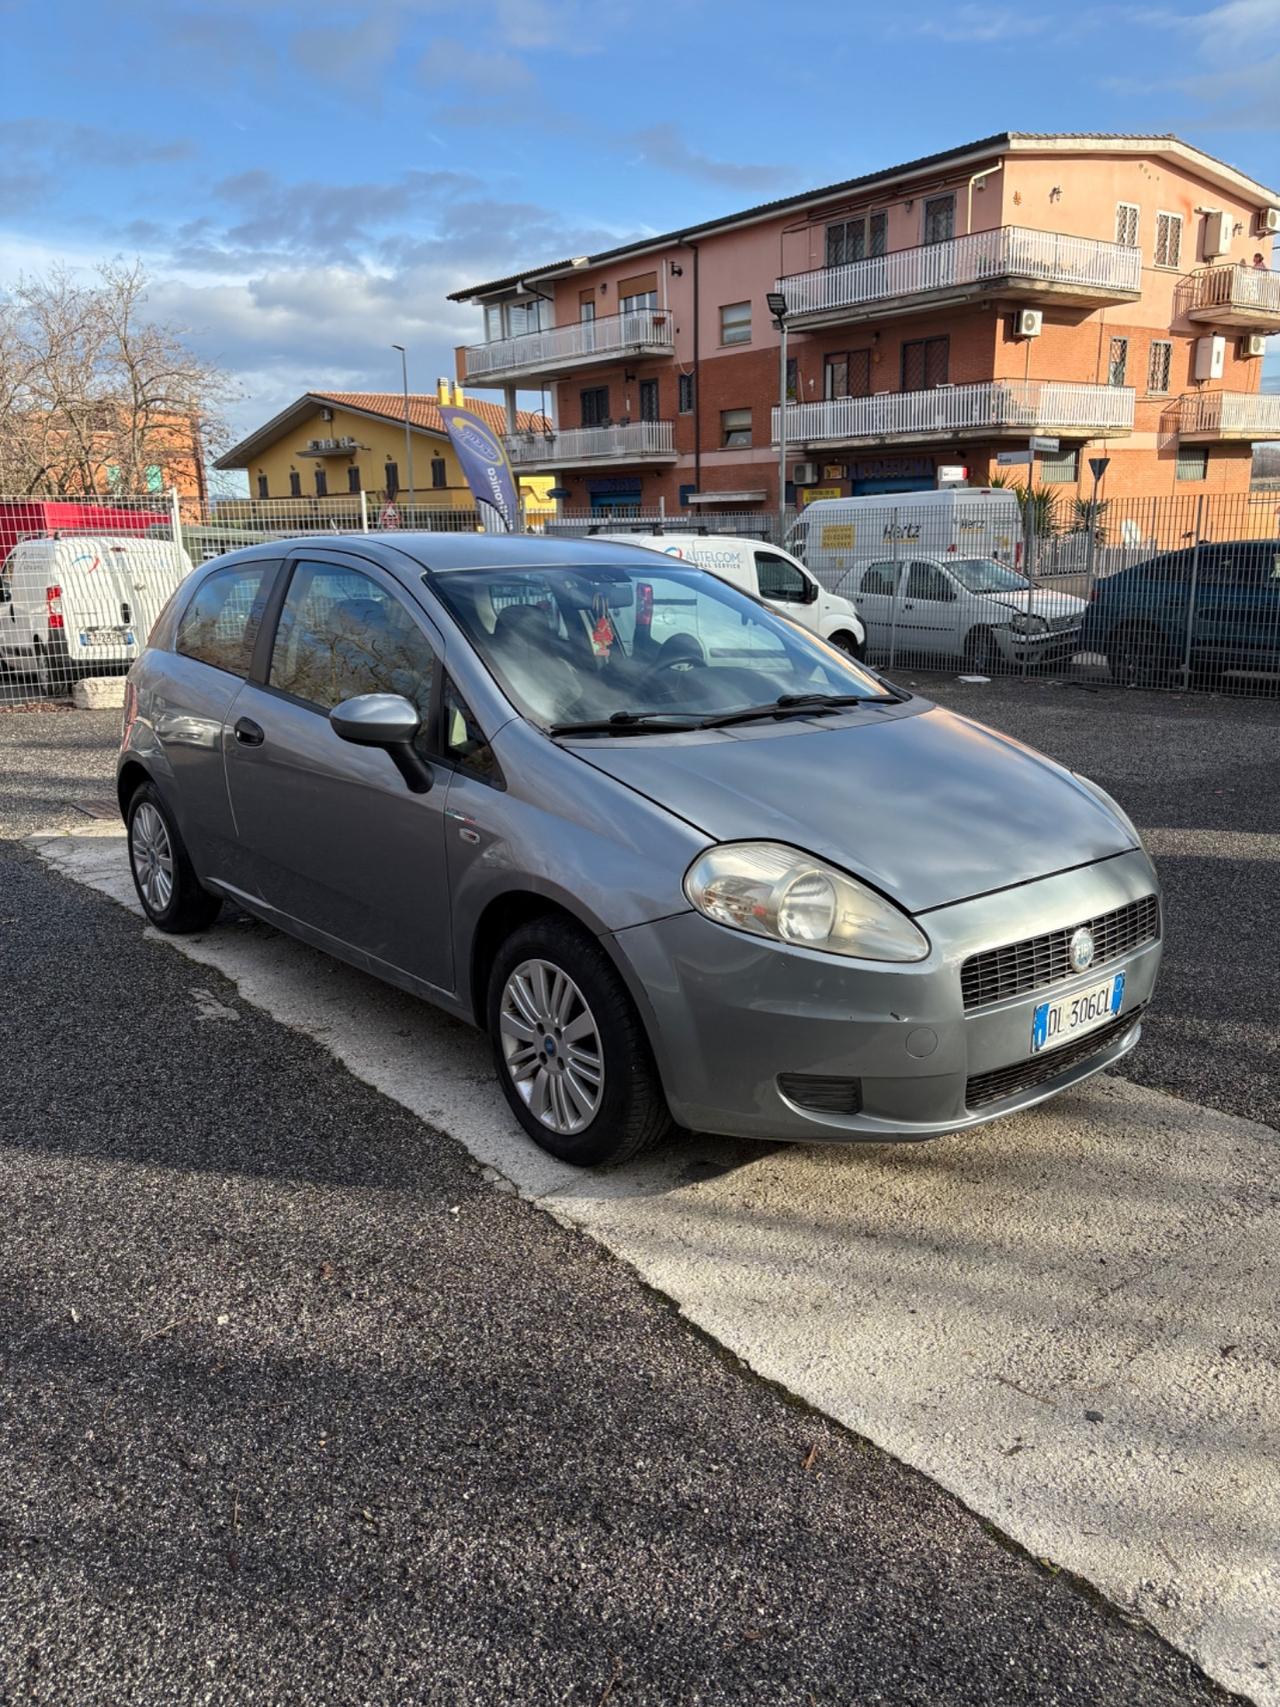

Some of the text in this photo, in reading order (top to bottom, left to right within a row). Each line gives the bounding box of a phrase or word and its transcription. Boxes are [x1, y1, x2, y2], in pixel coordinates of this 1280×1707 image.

[883, 523, 922, 540] Hertz
[1047, 988, 1110, 1037] DL 306CL
